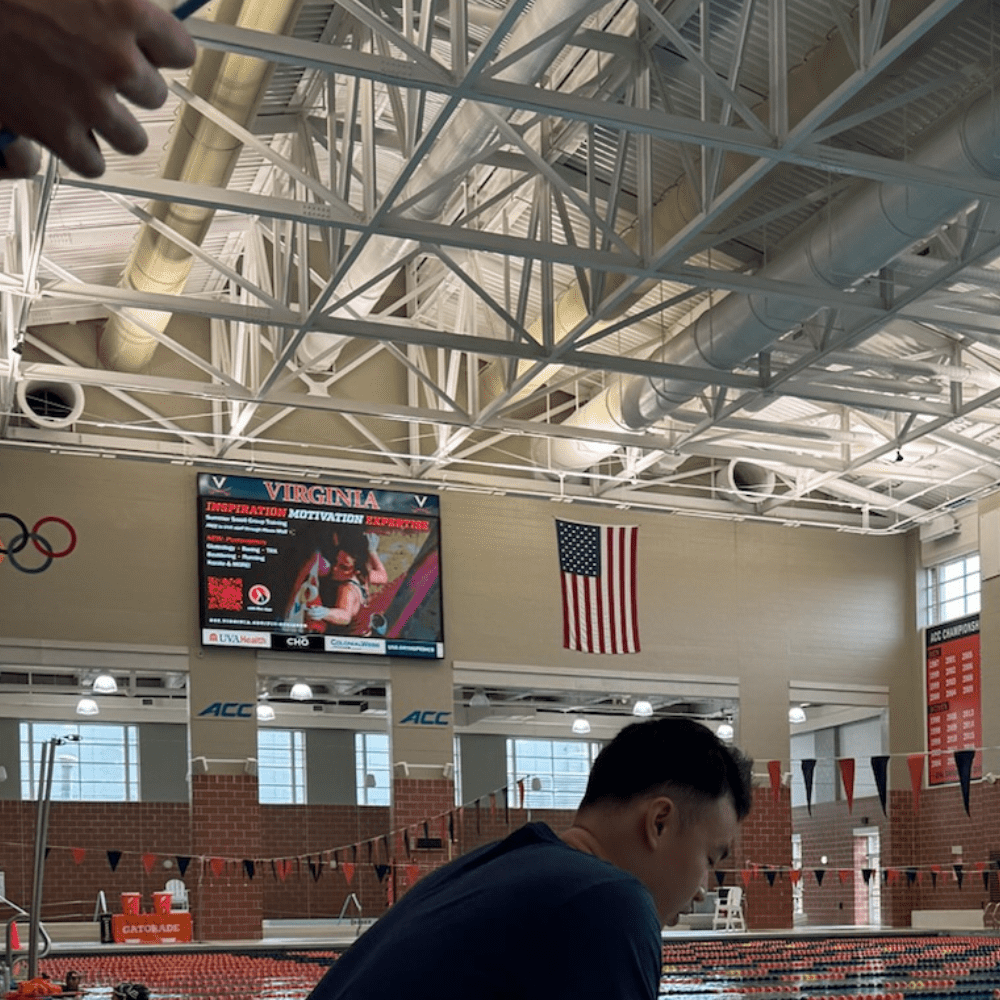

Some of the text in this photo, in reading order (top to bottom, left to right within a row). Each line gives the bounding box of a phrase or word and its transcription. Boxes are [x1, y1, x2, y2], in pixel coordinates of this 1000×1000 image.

[263, 481, 380, 509] VIRGINIA
[288, 508, 364, 524] MOTIVATION
[198, 702, 255, 718] ACC
[400, 710, 452, 725] ACC
[122, 924, 180, 934] GATORADE
